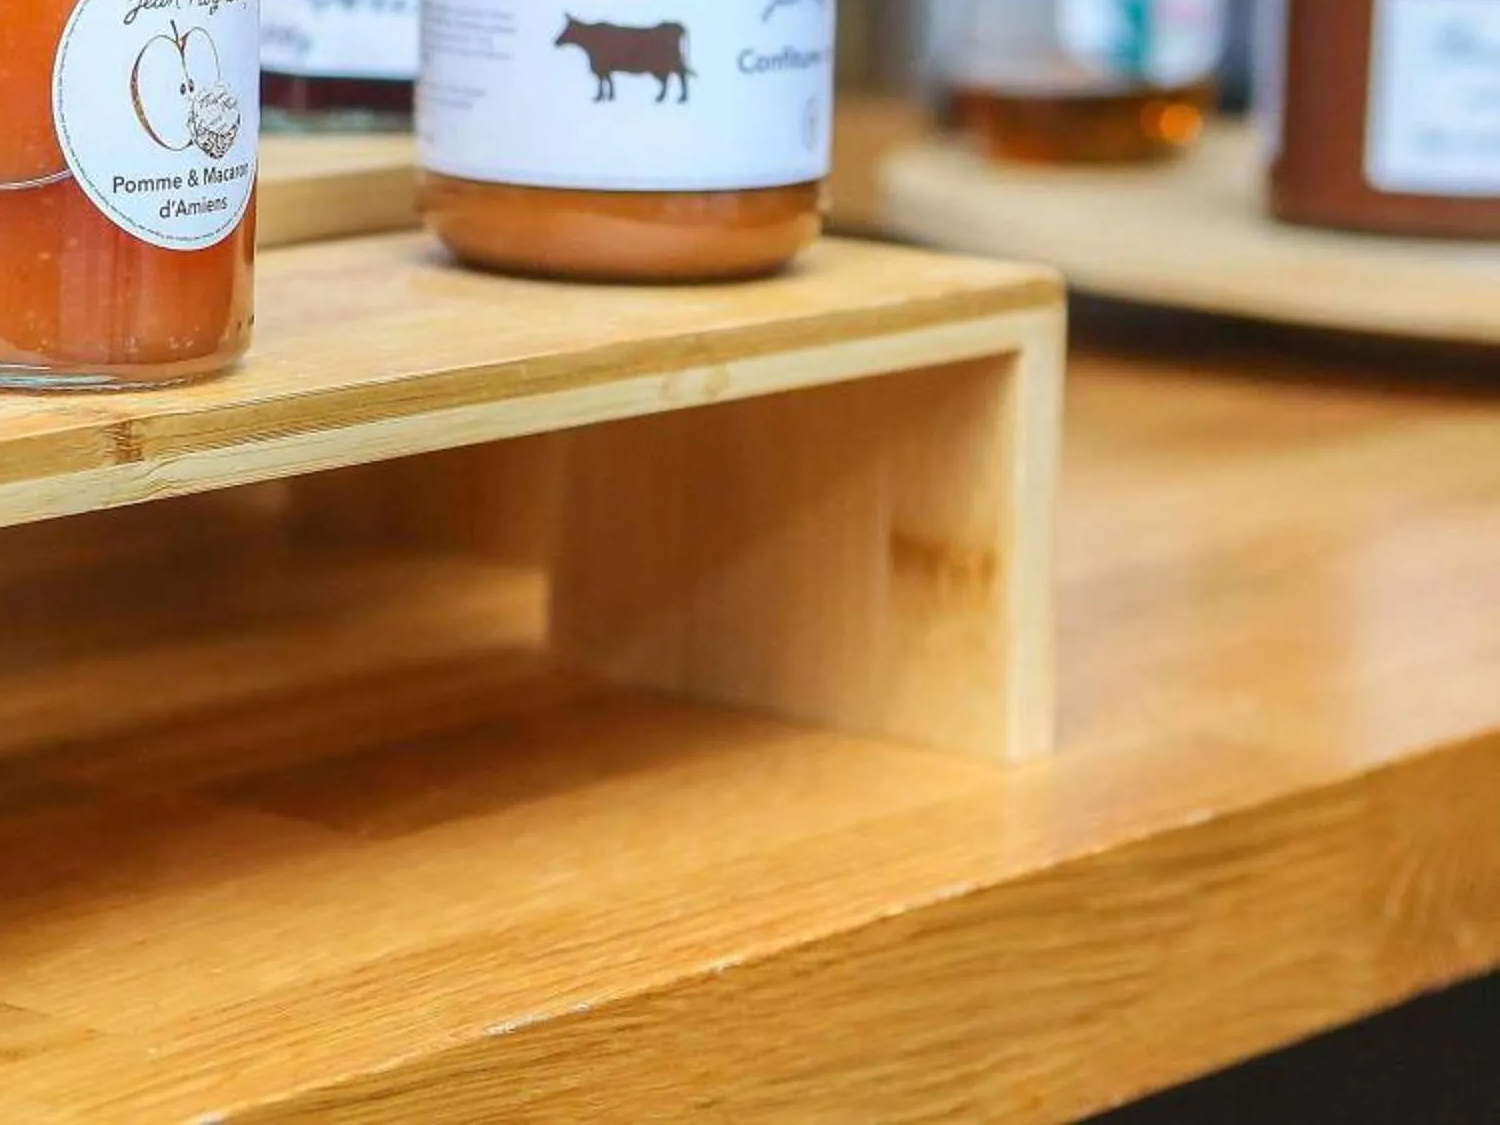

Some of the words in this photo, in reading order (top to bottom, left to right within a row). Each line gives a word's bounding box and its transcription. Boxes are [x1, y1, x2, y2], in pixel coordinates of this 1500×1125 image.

[112, 174, 183, 195] Pomme
[187, 167, 199, 189] &
[158, 196, 229, 219] d'Amiens
